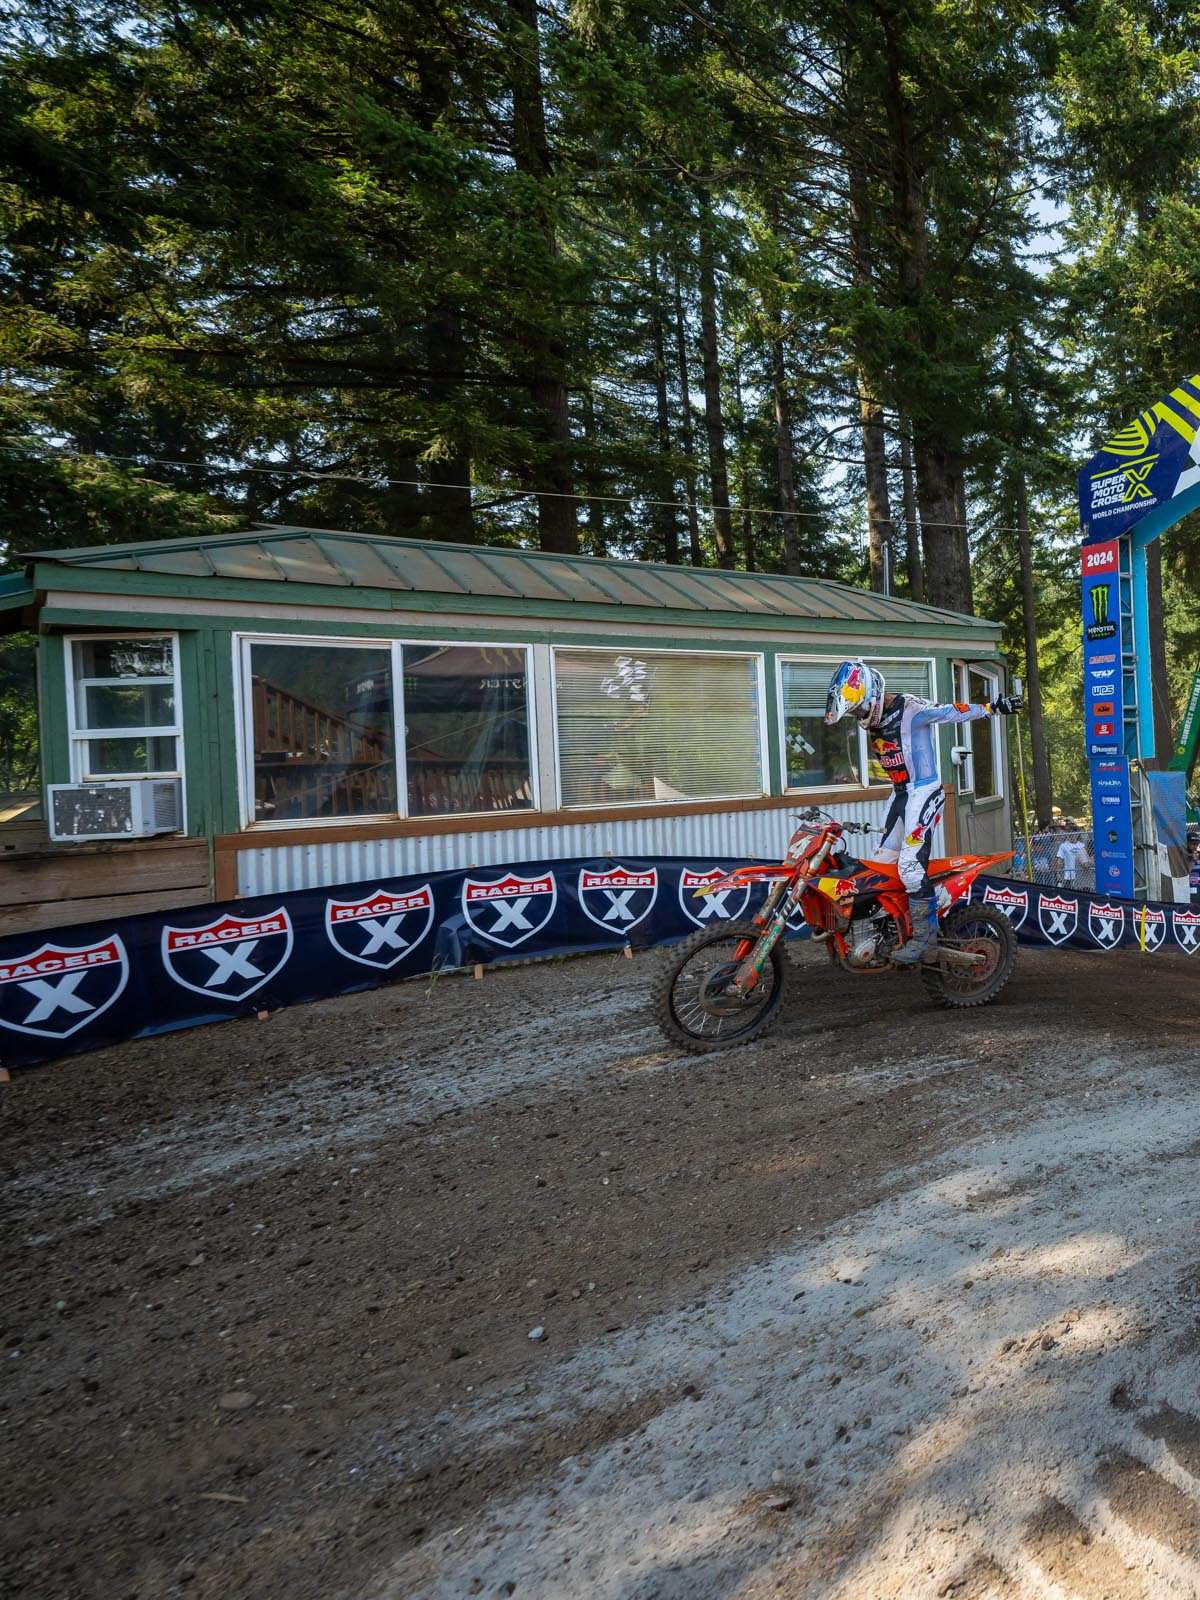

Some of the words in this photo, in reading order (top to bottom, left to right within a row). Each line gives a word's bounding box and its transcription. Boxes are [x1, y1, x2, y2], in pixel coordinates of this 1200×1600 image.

[1090, 474, 1126, 491] SUPER
[1093, 483, 1125, 499] MOTO
[1091, 492, 1125, 508] CROSS
[1092, 509, 1113, 520] WORLD
[1112, 497, 1157, 515] CHAMPIONSHIP
[1087, 550, 1113, 568] 2024
[1087, 624, 1115, 635] MONSTER
[1092, 684, 1115, 696] WPS
[1180, 711, 1194, 746] SUNBELT
[788, 834, 814, 859] 4
[587, 876, 651, 886] RACER
[471, 882, 548, 898] RACER
[988, 894, 1025, 904] RACER
[1041, 901, 1074, 912] RACER
[335, 896, 425, 919] RACER
[1092, 908, 1121, 918] RACER
[1135, 913, 1163, 922] RCER
[174, 920, 281, 949] RACER
